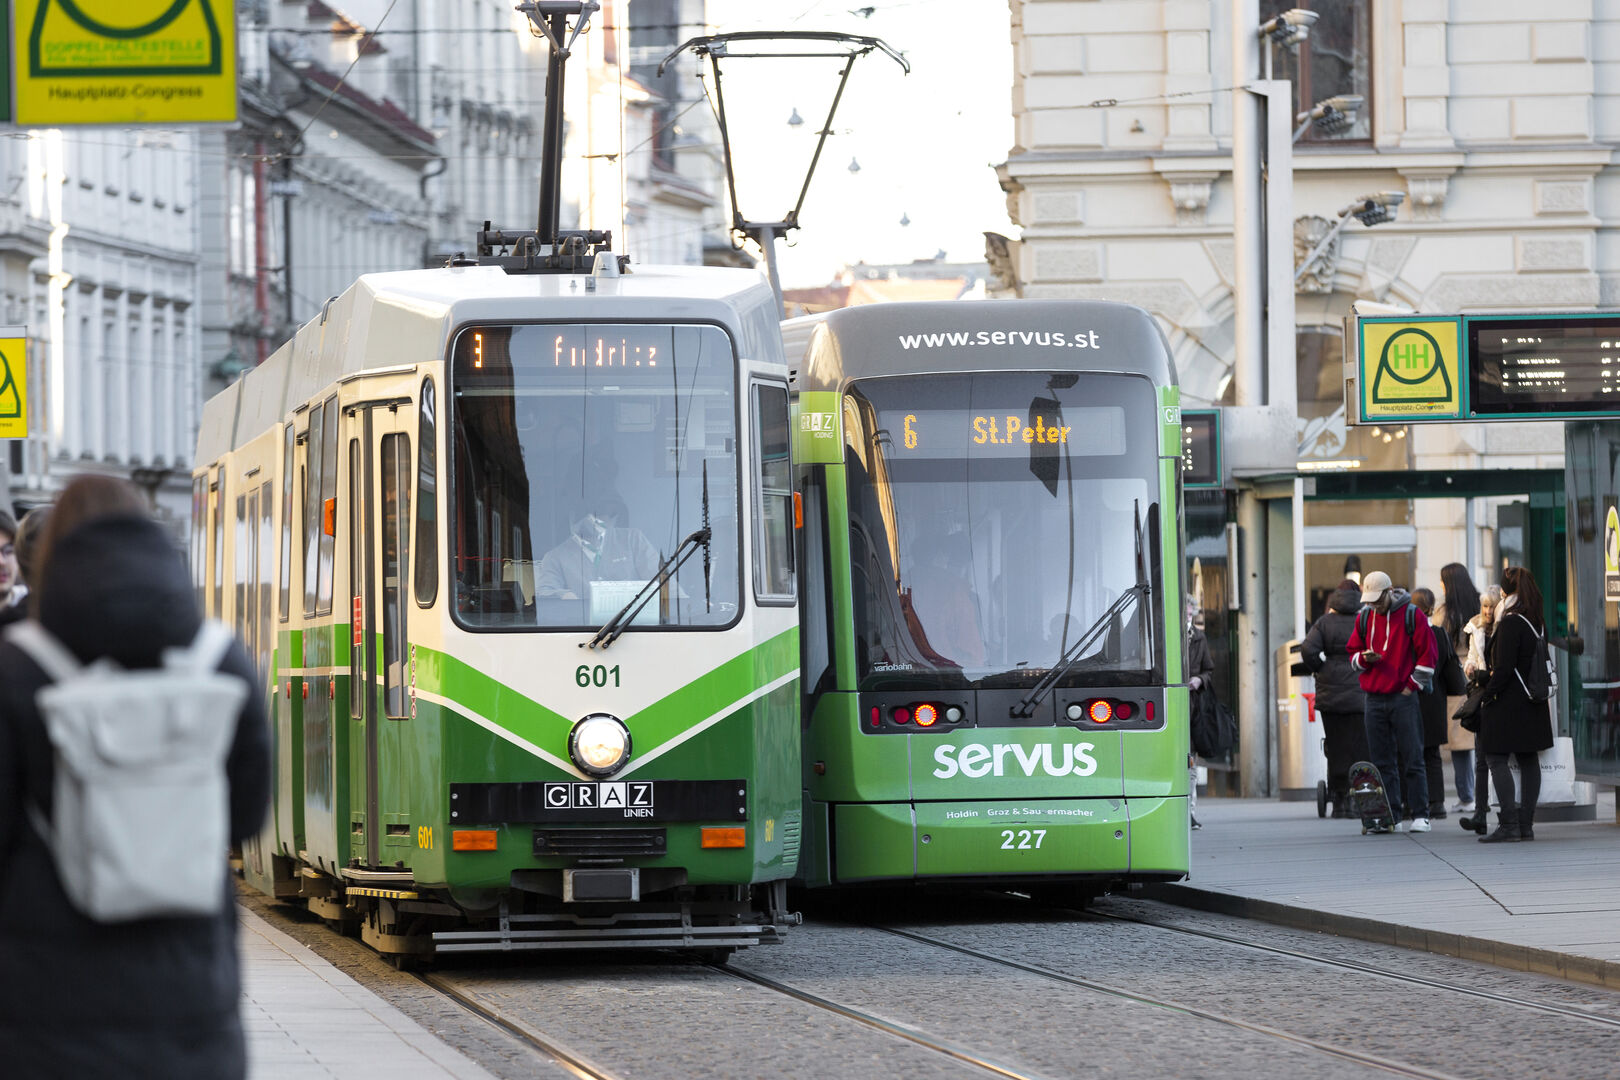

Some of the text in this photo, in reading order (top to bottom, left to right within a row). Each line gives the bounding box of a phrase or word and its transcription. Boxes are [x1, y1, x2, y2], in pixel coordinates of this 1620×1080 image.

[899, 330, 1100, 349] www.servus.st
[1393, 343, 1429, 369] HH
[903, 414, 1072, 449] 6 St.Peter
[575, 664, 620, 688] 601
[874, 662, 912, 672] variobahn
[933, 742, 1098, 779] servus
[546, 784, 652, 808] GRAZ
[623, 808, 654, 818] LINIEN
[1012, 807, 1021, 815] &
[1022, 807, 1094, 817] Sauermacher
[418, 825, 433, 850] 601
[1000, 829, 1047, 850] 227
